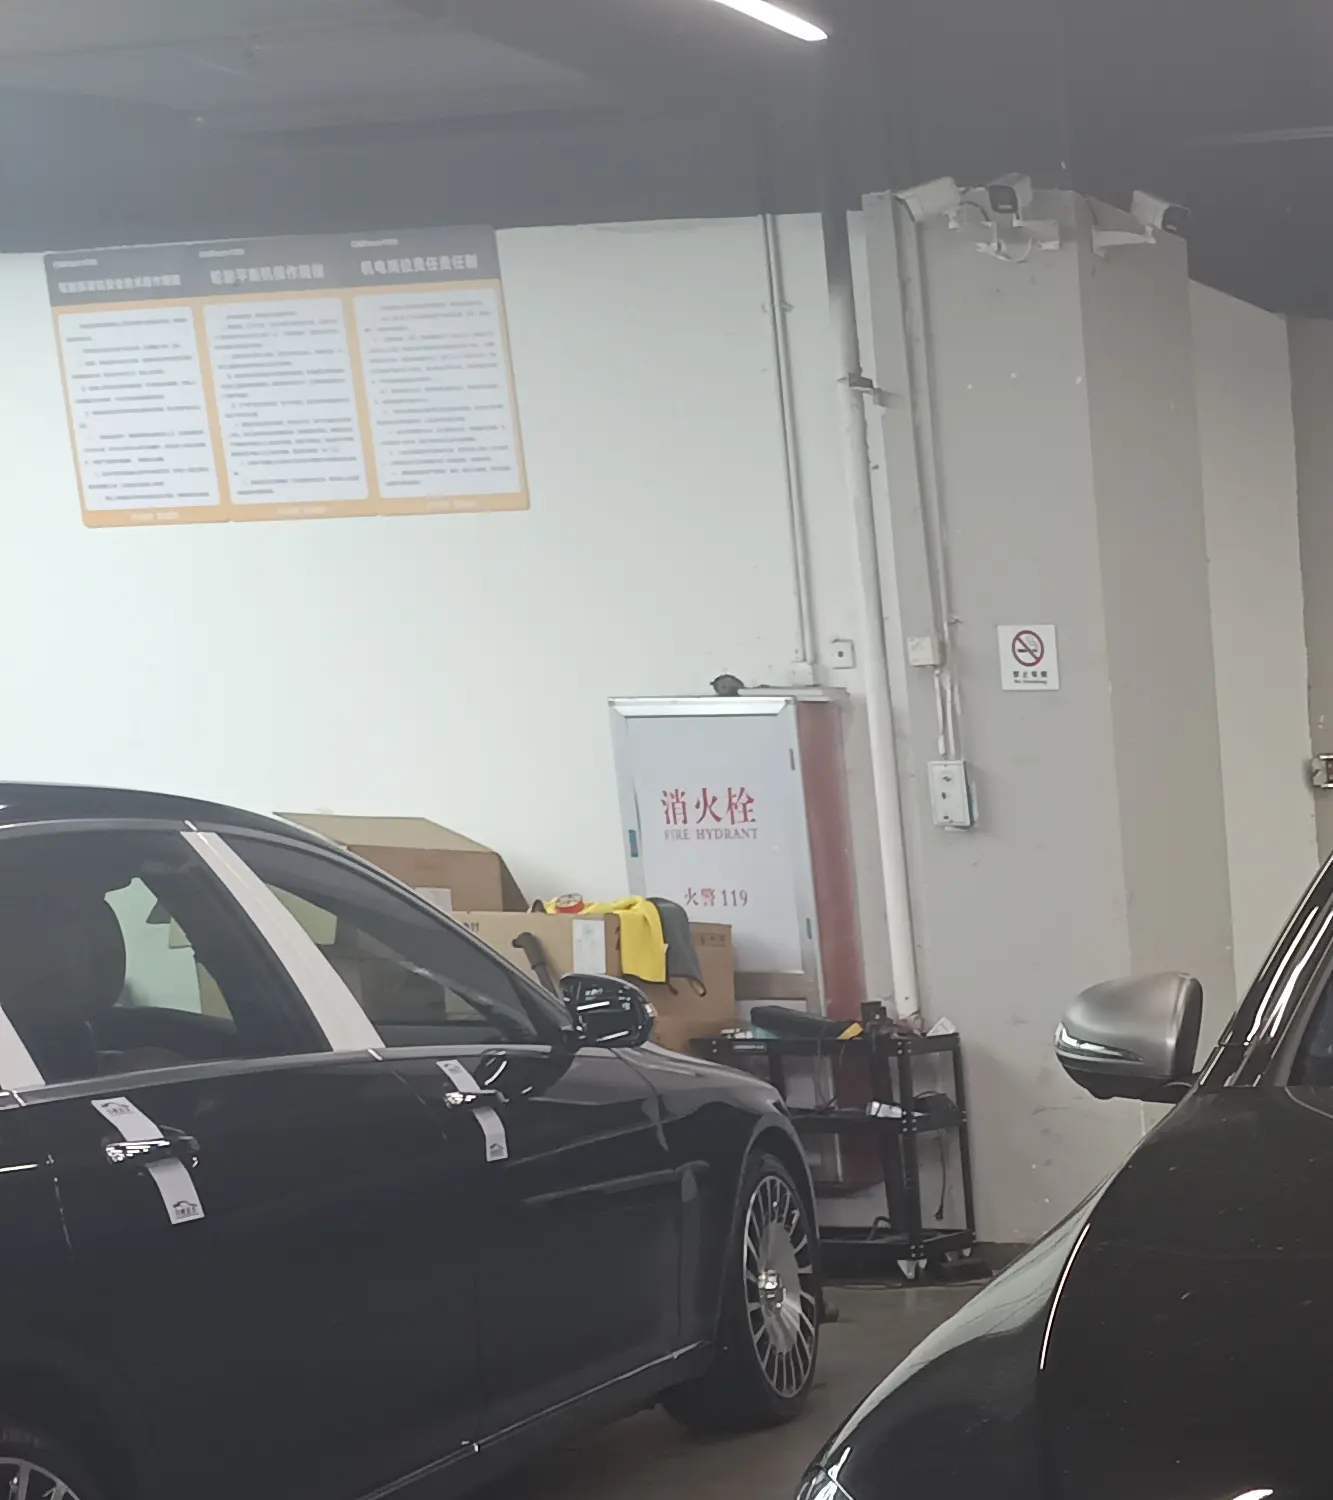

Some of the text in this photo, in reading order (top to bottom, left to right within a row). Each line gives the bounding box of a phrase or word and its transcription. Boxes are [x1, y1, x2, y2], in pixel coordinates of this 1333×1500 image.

[660, 787, 756, 825] 消火栓
[664, 828, 758, 841] FIRE HYDRANT
